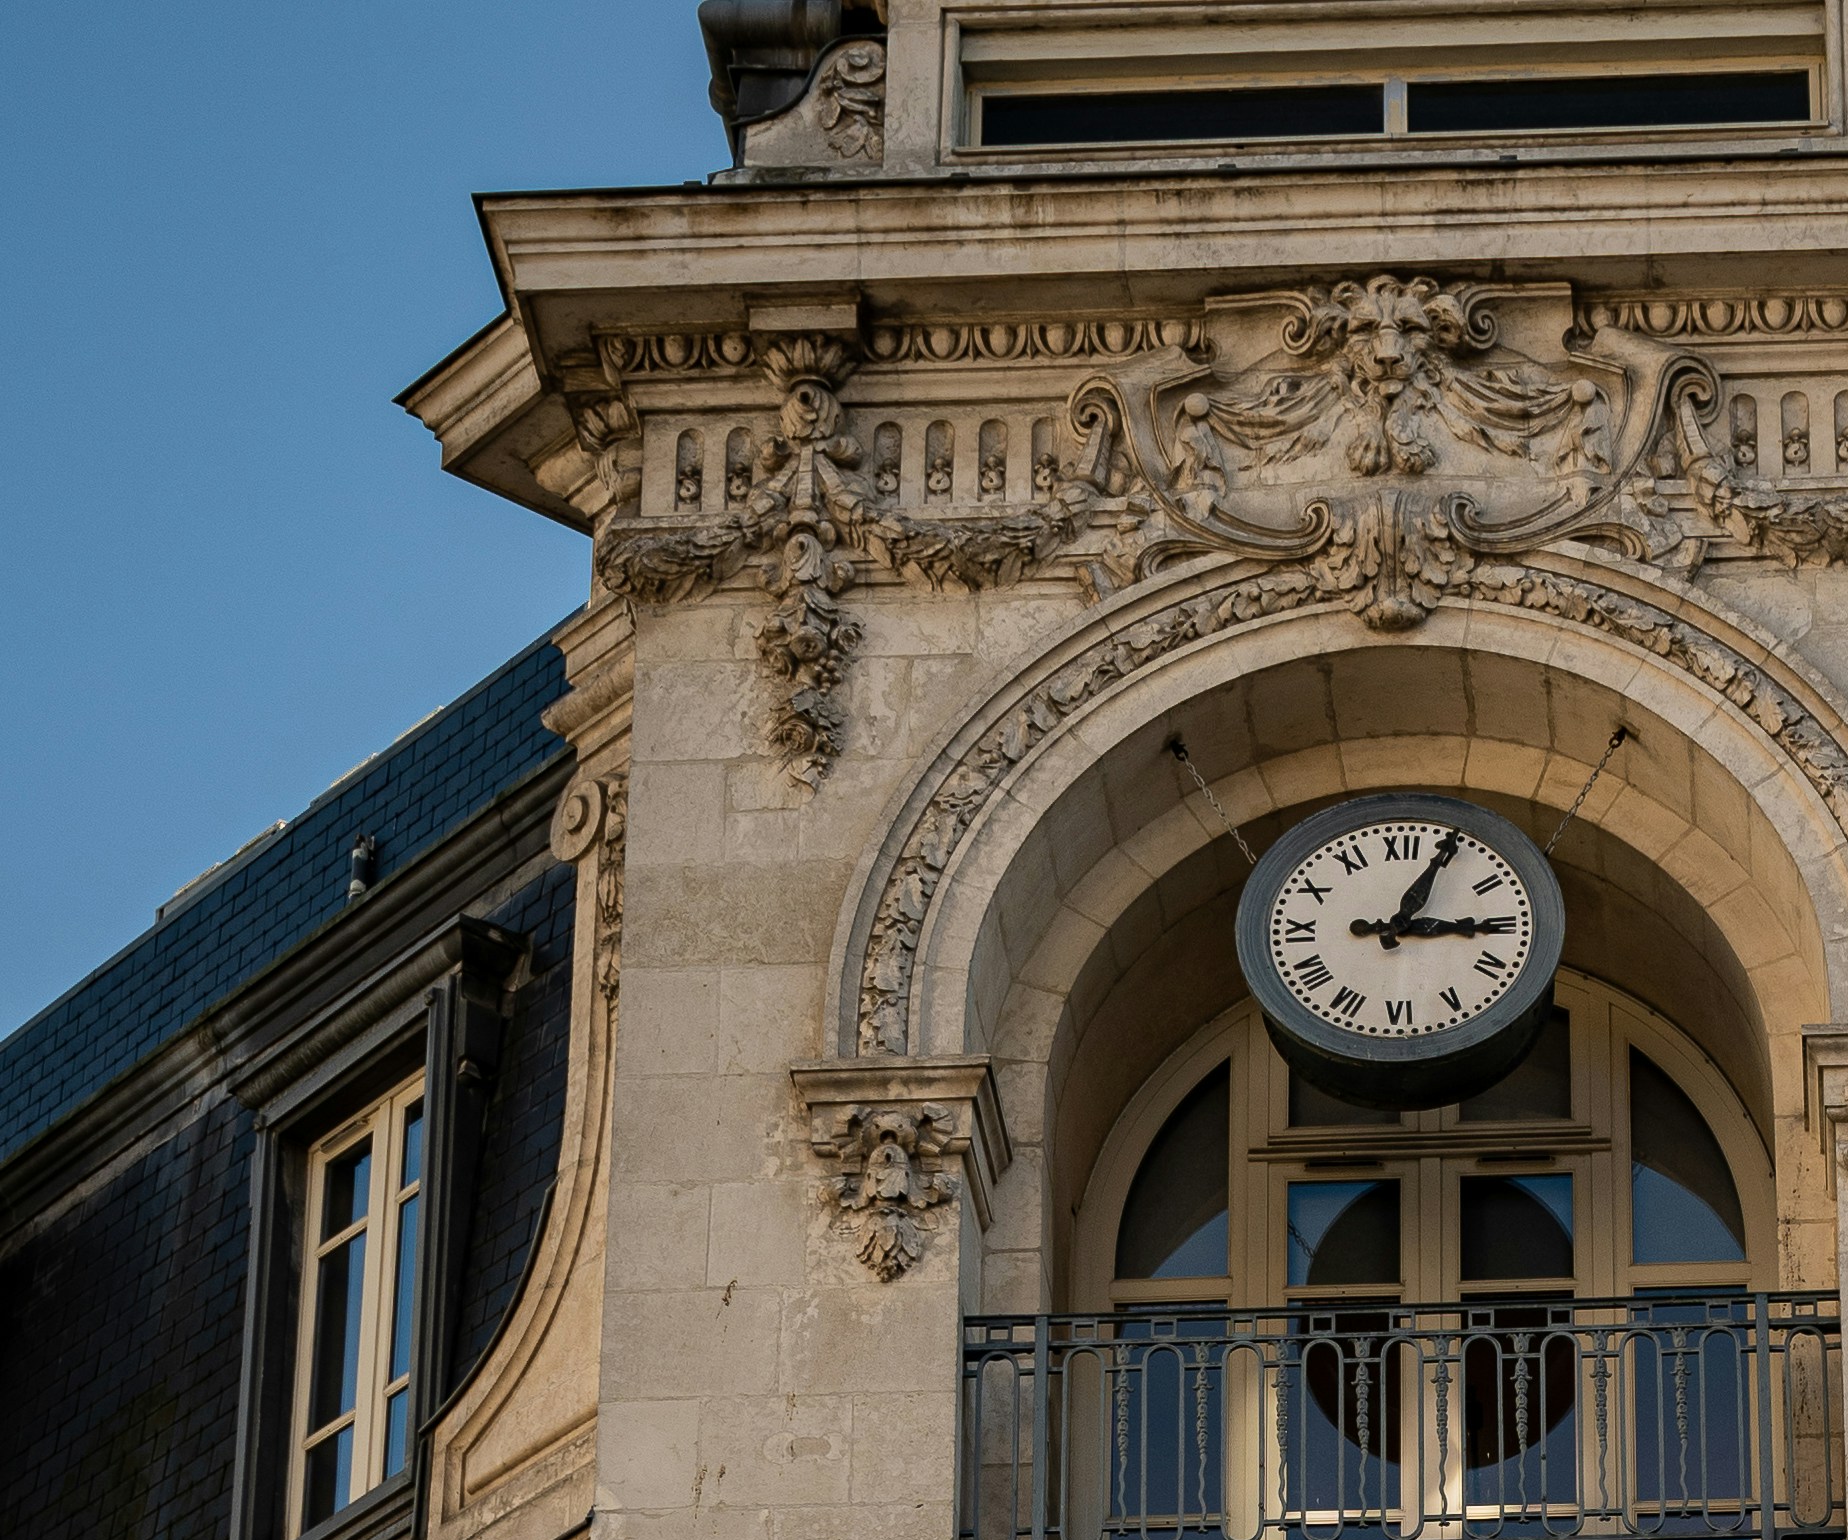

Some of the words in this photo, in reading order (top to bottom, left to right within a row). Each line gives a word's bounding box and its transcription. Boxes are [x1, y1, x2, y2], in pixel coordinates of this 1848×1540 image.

[1332, 844, 1369, 876] XI
[1382, 834, 1421, 862] XII
[1296, 877, 1333, 905] X
[1471, 873, 1504, 896] II
[1284, 918, 1317, 944] IX
[1292, 953, 1334, 991] VIII
[1473, 950, 1507, 980] IV
[1329, 985, 1367, 1018] VII
[1384, 999, 1413, 1026] VI
[1438, 986, 1462, 1013] V
